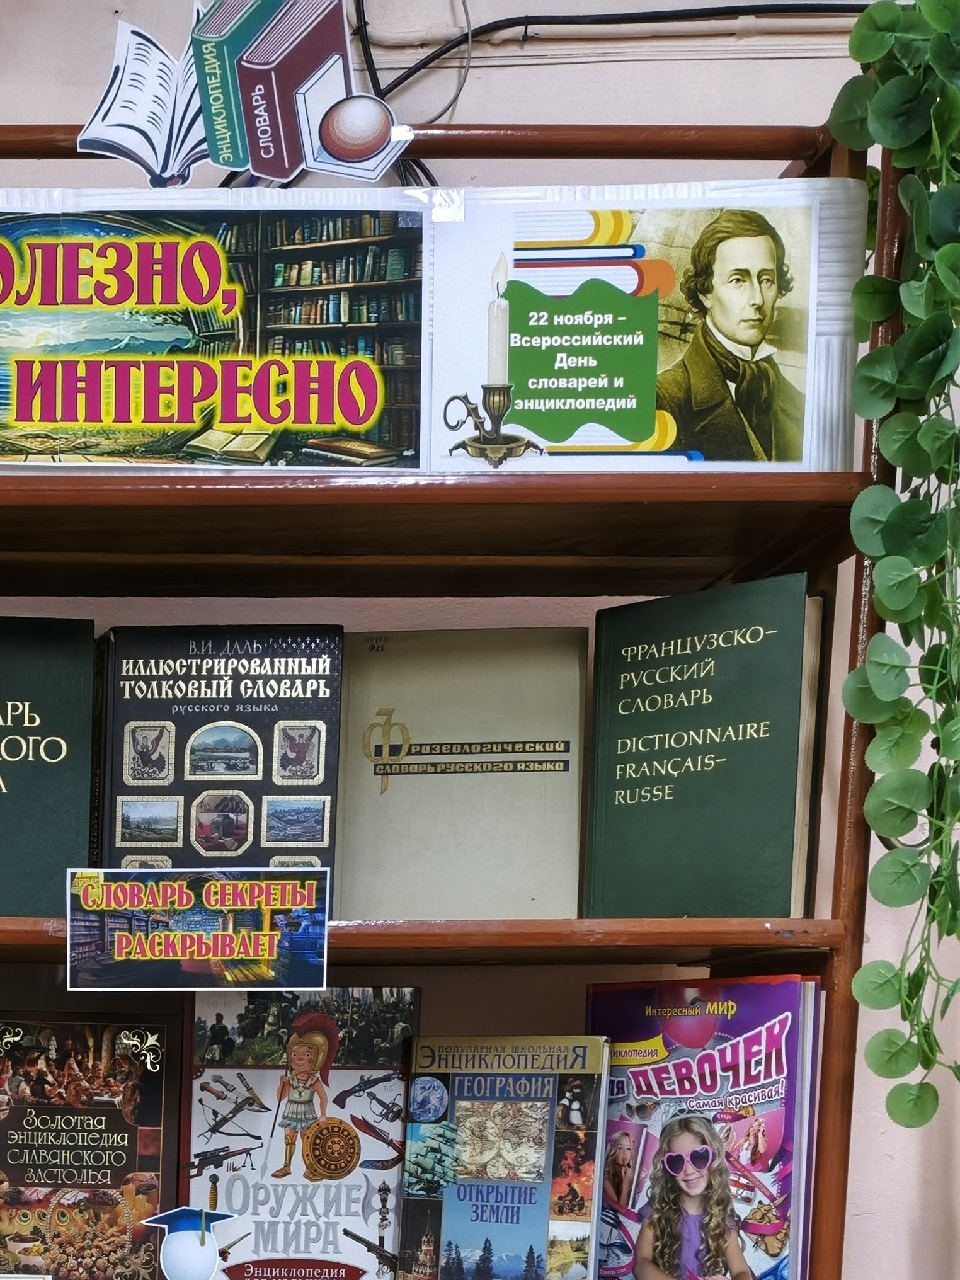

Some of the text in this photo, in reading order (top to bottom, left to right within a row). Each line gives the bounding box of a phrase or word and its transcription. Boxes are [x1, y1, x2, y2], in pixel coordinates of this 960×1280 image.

[204, 41, 234, 162] ЭНЦИКЛОПЕДИЯ
[251, 84, 274, 158] СЛОВАРЬ
[528, 311, 614, 328] 22 ноября
[510, 331, 644, 349] Всероссийский
[554, 354, 597, 370] День
[15, 359, 379, 427] ИНТЕРЕСНО
[528, 375, 624, 391] словарей и
[513, 395, 637, 412] энциклопедий
[219, 639, 262, 657] ДАЛЬ
[120, 655, 331, 677] ИЛЛЮСТРИРОВАННЫЙ
[620, 659, 715, 690] РУССКИЙ
[120, 677, 331, 699] ТОЛКОВЫЙ СЛОВАРЬ
[172, 703, 279, 714] русского языка
[618, 689, 713, 716] СЛОВАРЬ
[616, 721, 770, 754] DICTIONNAIRE
[614, 785, 674, 805] RUSSE
[81, 882, 316, 911] СЛОВАРЬ СЕКРЕТЫ
[115, 932, 279, 960] РАСКРЫВАЕТ
[645, 1004, 701, 1018] Интересный
[418, 1045, 588, 1070] ЭНЦИКЛОПЕДИЯ
[633, 1018, 789, 1099] ДЕВОЧЕК
[454, 1076, 554, 1098] ГЕОГРАФИЯ
[688, 1079, 785, 1110] Самая красивая!
[456, 1183, 538, 1205] ОТКРЫТИЕ
[470, 1204, 521, 1225] ЗЕМЛИ
[252, 1219, 343, 1256] МИРА
[244, 1263, 346, 1279] Энциклопедия
